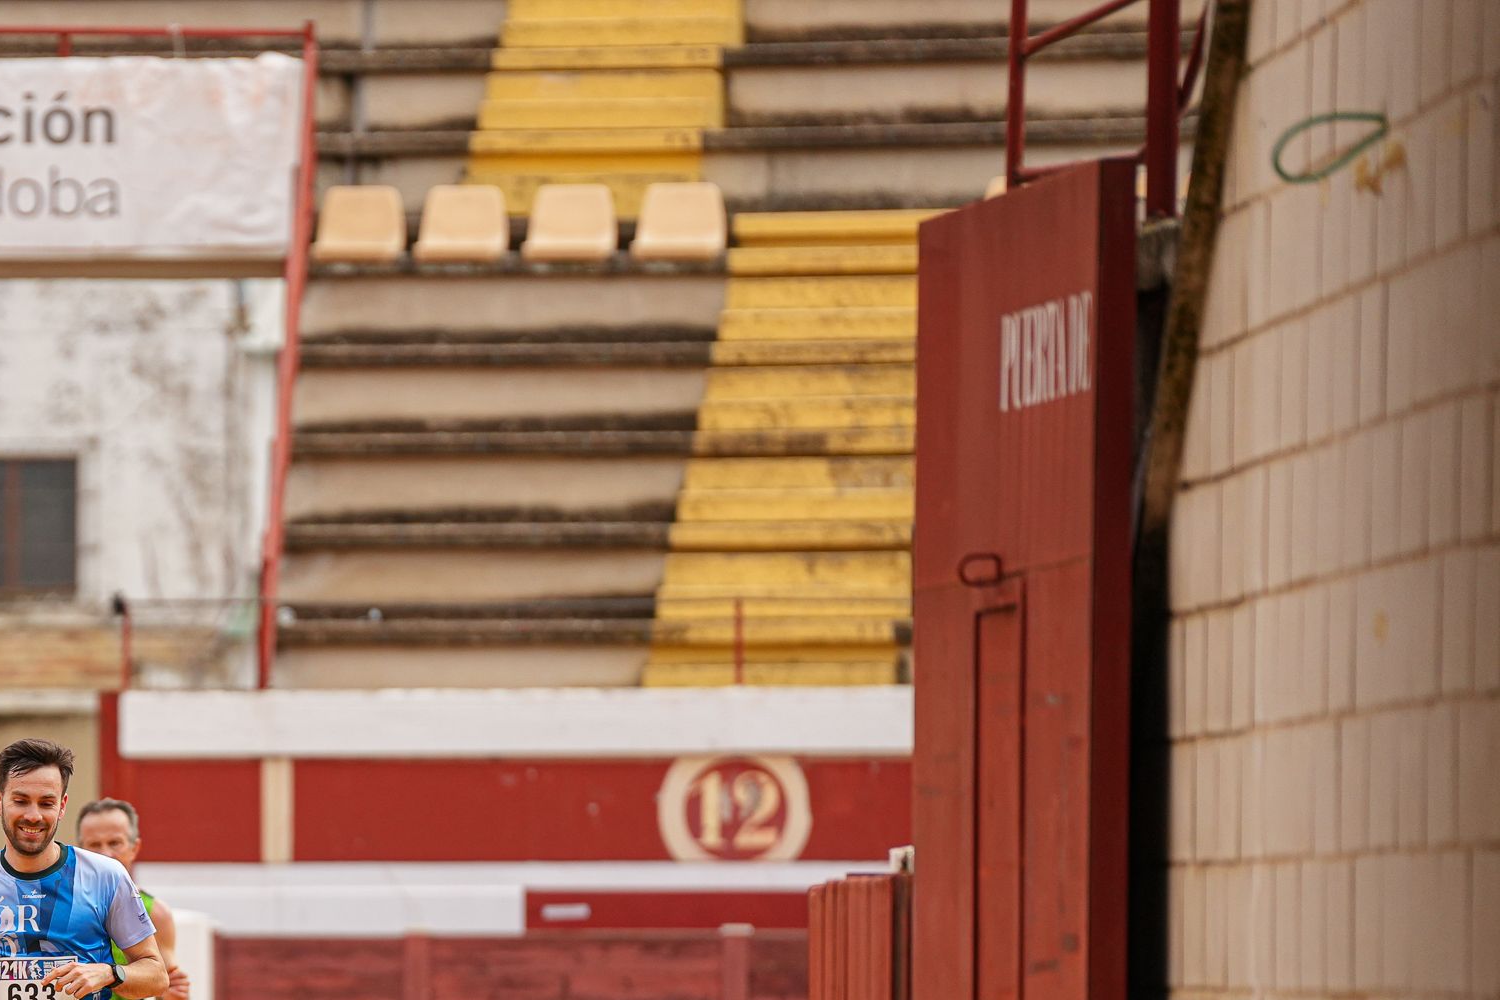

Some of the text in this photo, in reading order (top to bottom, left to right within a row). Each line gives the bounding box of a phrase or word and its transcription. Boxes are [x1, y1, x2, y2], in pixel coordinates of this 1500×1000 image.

[999, 298, 1067, 412] PUERTA
[689, 769, 780, 849] 12
[2, 961, 28, 980] 21K
